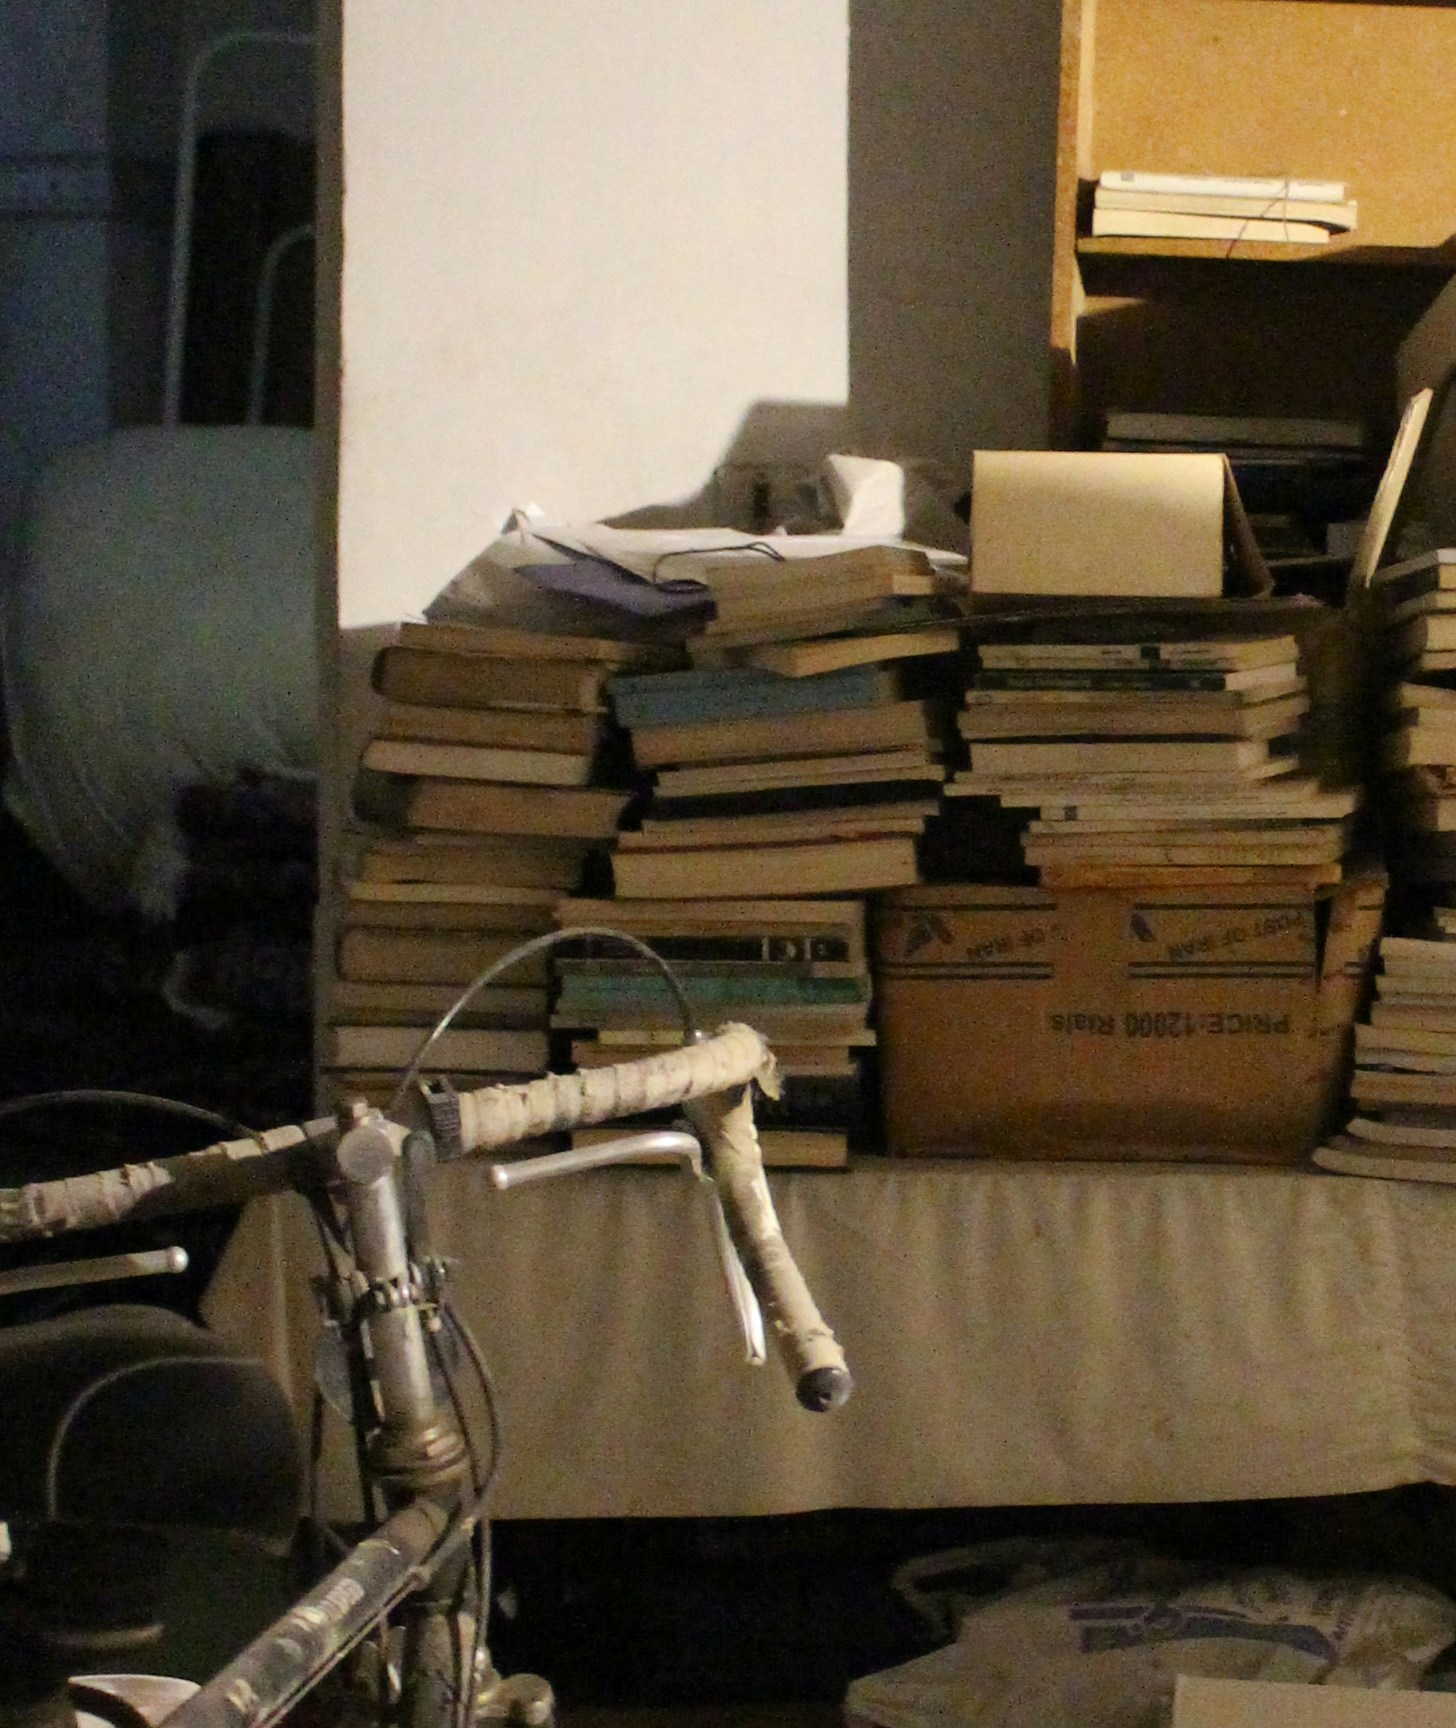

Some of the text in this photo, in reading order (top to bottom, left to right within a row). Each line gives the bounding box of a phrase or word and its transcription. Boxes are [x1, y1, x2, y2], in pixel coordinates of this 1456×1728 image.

[1019, 927, 1045, 947] OF
[1221, 926, 1249, 946] OF
[965, 935, 1013, 962] IRAN
[1167, 936, 1214, 963] IRAN
